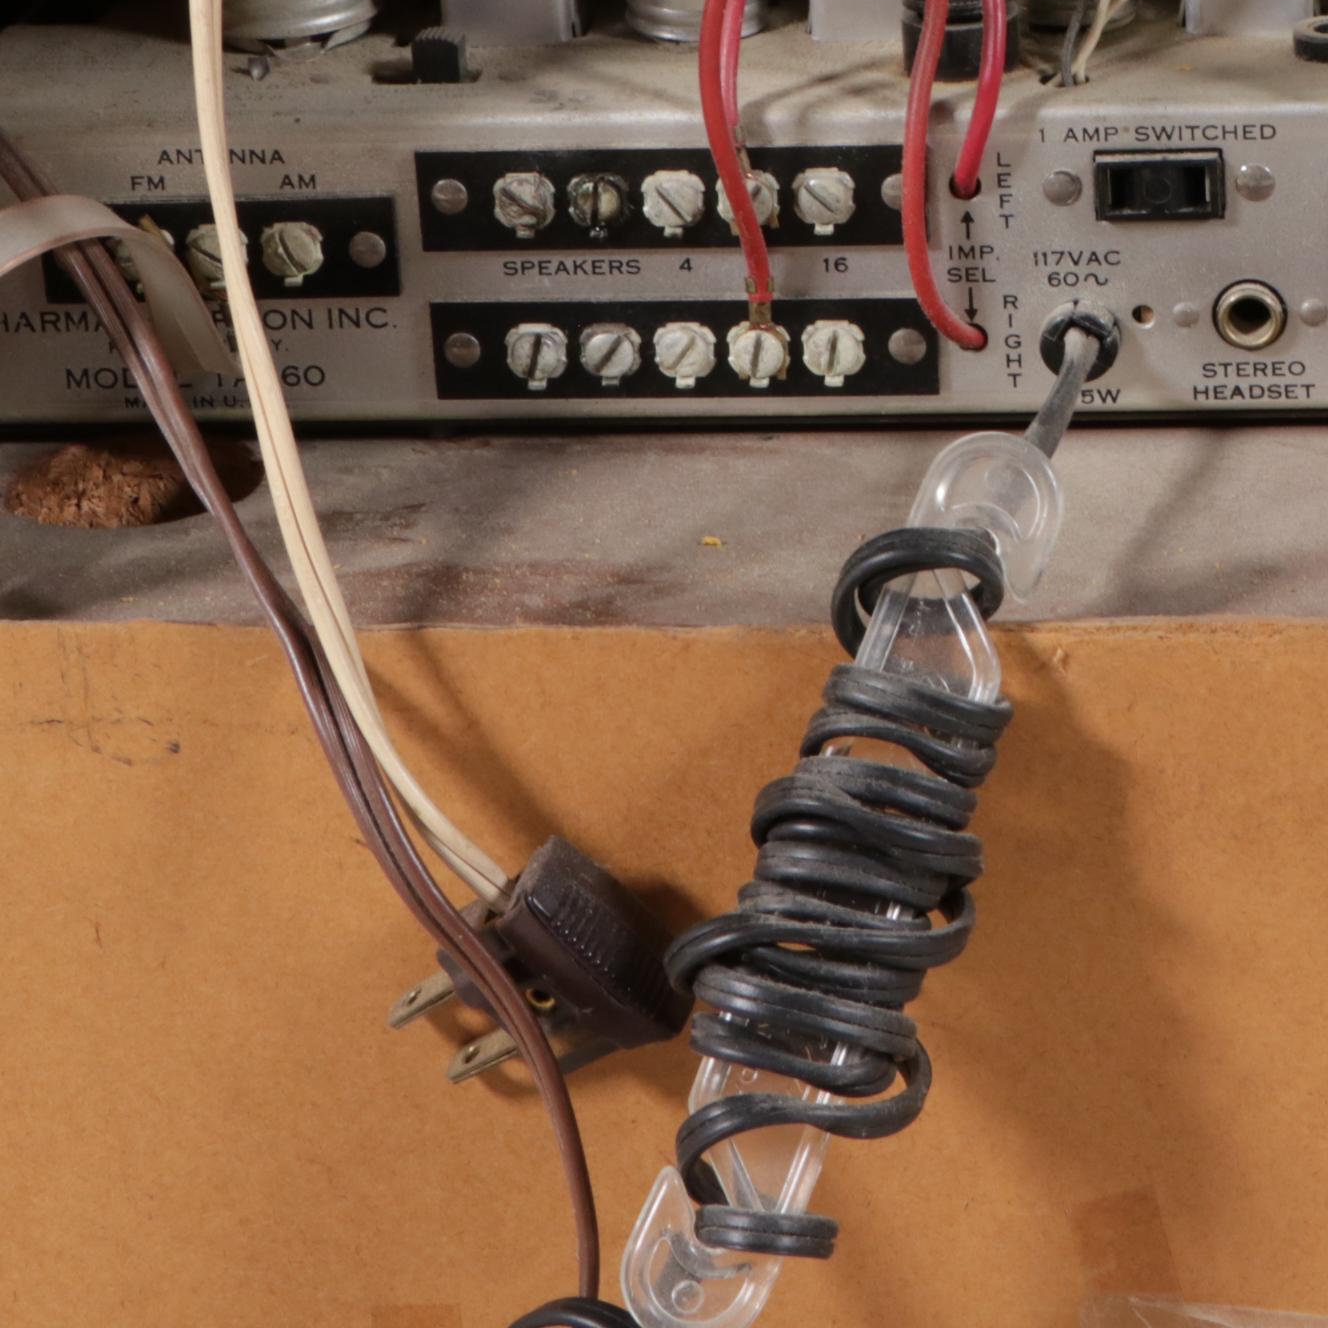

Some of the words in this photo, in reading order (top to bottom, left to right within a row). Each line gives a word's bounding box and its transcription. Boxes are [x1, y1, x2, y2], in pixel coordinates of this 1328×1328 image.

[1039, 127, 1046, 144] 1
[1063, 126, 1119, 143] AMP
[1134, 123, 1277, 143] SWITCHED
[156, 147, 286, 166] ANTNNA
[130, 174, 166, 192] FM
[279, 173, 317, 190] AM
[996, 151, 1015, 230] LEFT
[948, 244, 1000, 261] IMP.
[1032, 249, 1121, 267] 117VAC
[502, 258, 641, 277] SPEAKERS
[678, 257, 693, 272] 4
[823, 256, 849, 274] 16
[946, 266, 997, 284] SEL
[327, 306, 397, 330] INC.
[1002, 294, 1023, 389] RIGHT
[1201, 360, 1307, 379] STEREO
[1192, 383, 1316, 401] HEADSET
